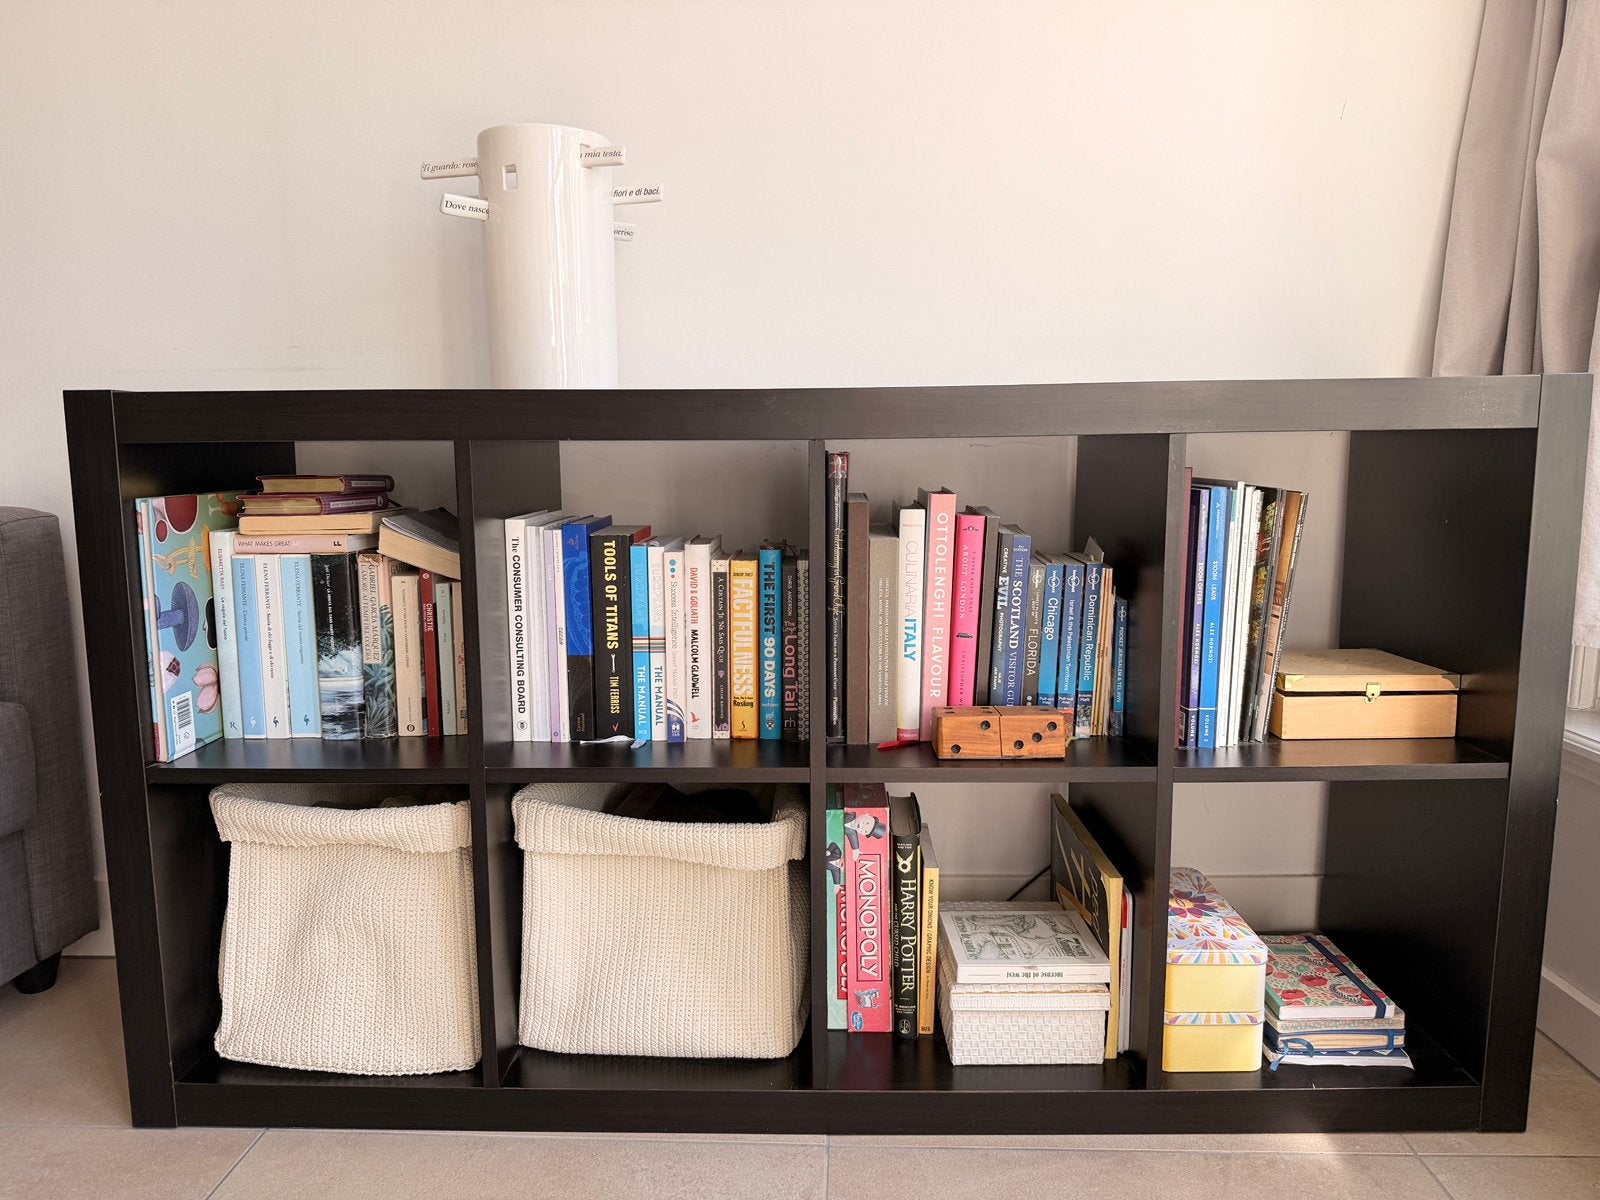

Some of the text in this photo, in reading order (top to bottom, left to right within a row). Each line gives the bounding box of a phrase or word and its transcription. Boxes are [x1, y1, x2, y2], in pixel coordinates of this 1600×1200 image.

[430, 162, 461, 173] guardo:
[584, 149, 622, 158] mia testa.
[444, 200, 466, 210] Dove
[614, 189, 627, 198] fiori
[635, 187, 642, 196] di
[644, 186, 660, 196] baci.
[512, 536, 520, 552] The
[369, 564, 377, 594] GABRIEL
[513, 554, 523, 612] CONSUMER
[690, 568, 698, 588] DAVID
[1014, 558, 1023, 577] THE
[690, 596, 698, 624] GOLIATH
[930, 513, 948, 698] OTTOLENGHI FLAVOUR
[959, 581, 967, 619] LONDON
[996, 576, 1010, 610] EVIL
[426, 604, 434, 631] CHRISTIE
[604, 541, 620, 714] TOOLS OF TITANS TIM FERRISS
[671, 610, 680, 648] Intelligence
[764, 562, 776, 698] THE FIRST 90 DAYS
[1009, 580, 1022, 648] SCOTLAND
[1044, 598, 1058, 640] Chicago
[515, 614, 525, 676] CONSULTING
[690, 630, 698, 664] MALCOLM
[732, 580, 754, 696] FACTFULNESS
[783, 634, 796, 678] Long
[1026, 628, 1038, 676] FLORIDA
[1066, 632, 1074, 661] Palestinian
[1083, 595, 1098, 680] Dominican Republic
[691, 664, 700, 699] GLADWELL
[1008, 652, 1017, 688] VISITOR
[517, 680, 526, 714] BOARD
[637, 666, 649, 726] THE MANUAL
[654, 666, 664, 726] THE MANUAL
[733, 700, 754, 708] Rosling
[785, 680, 799, 712] Tail
[859, 860, 878, 978] MONOPOLY
[901, 878, 916, 930] HARRY
[901, 935, 916, 994] POTTER
